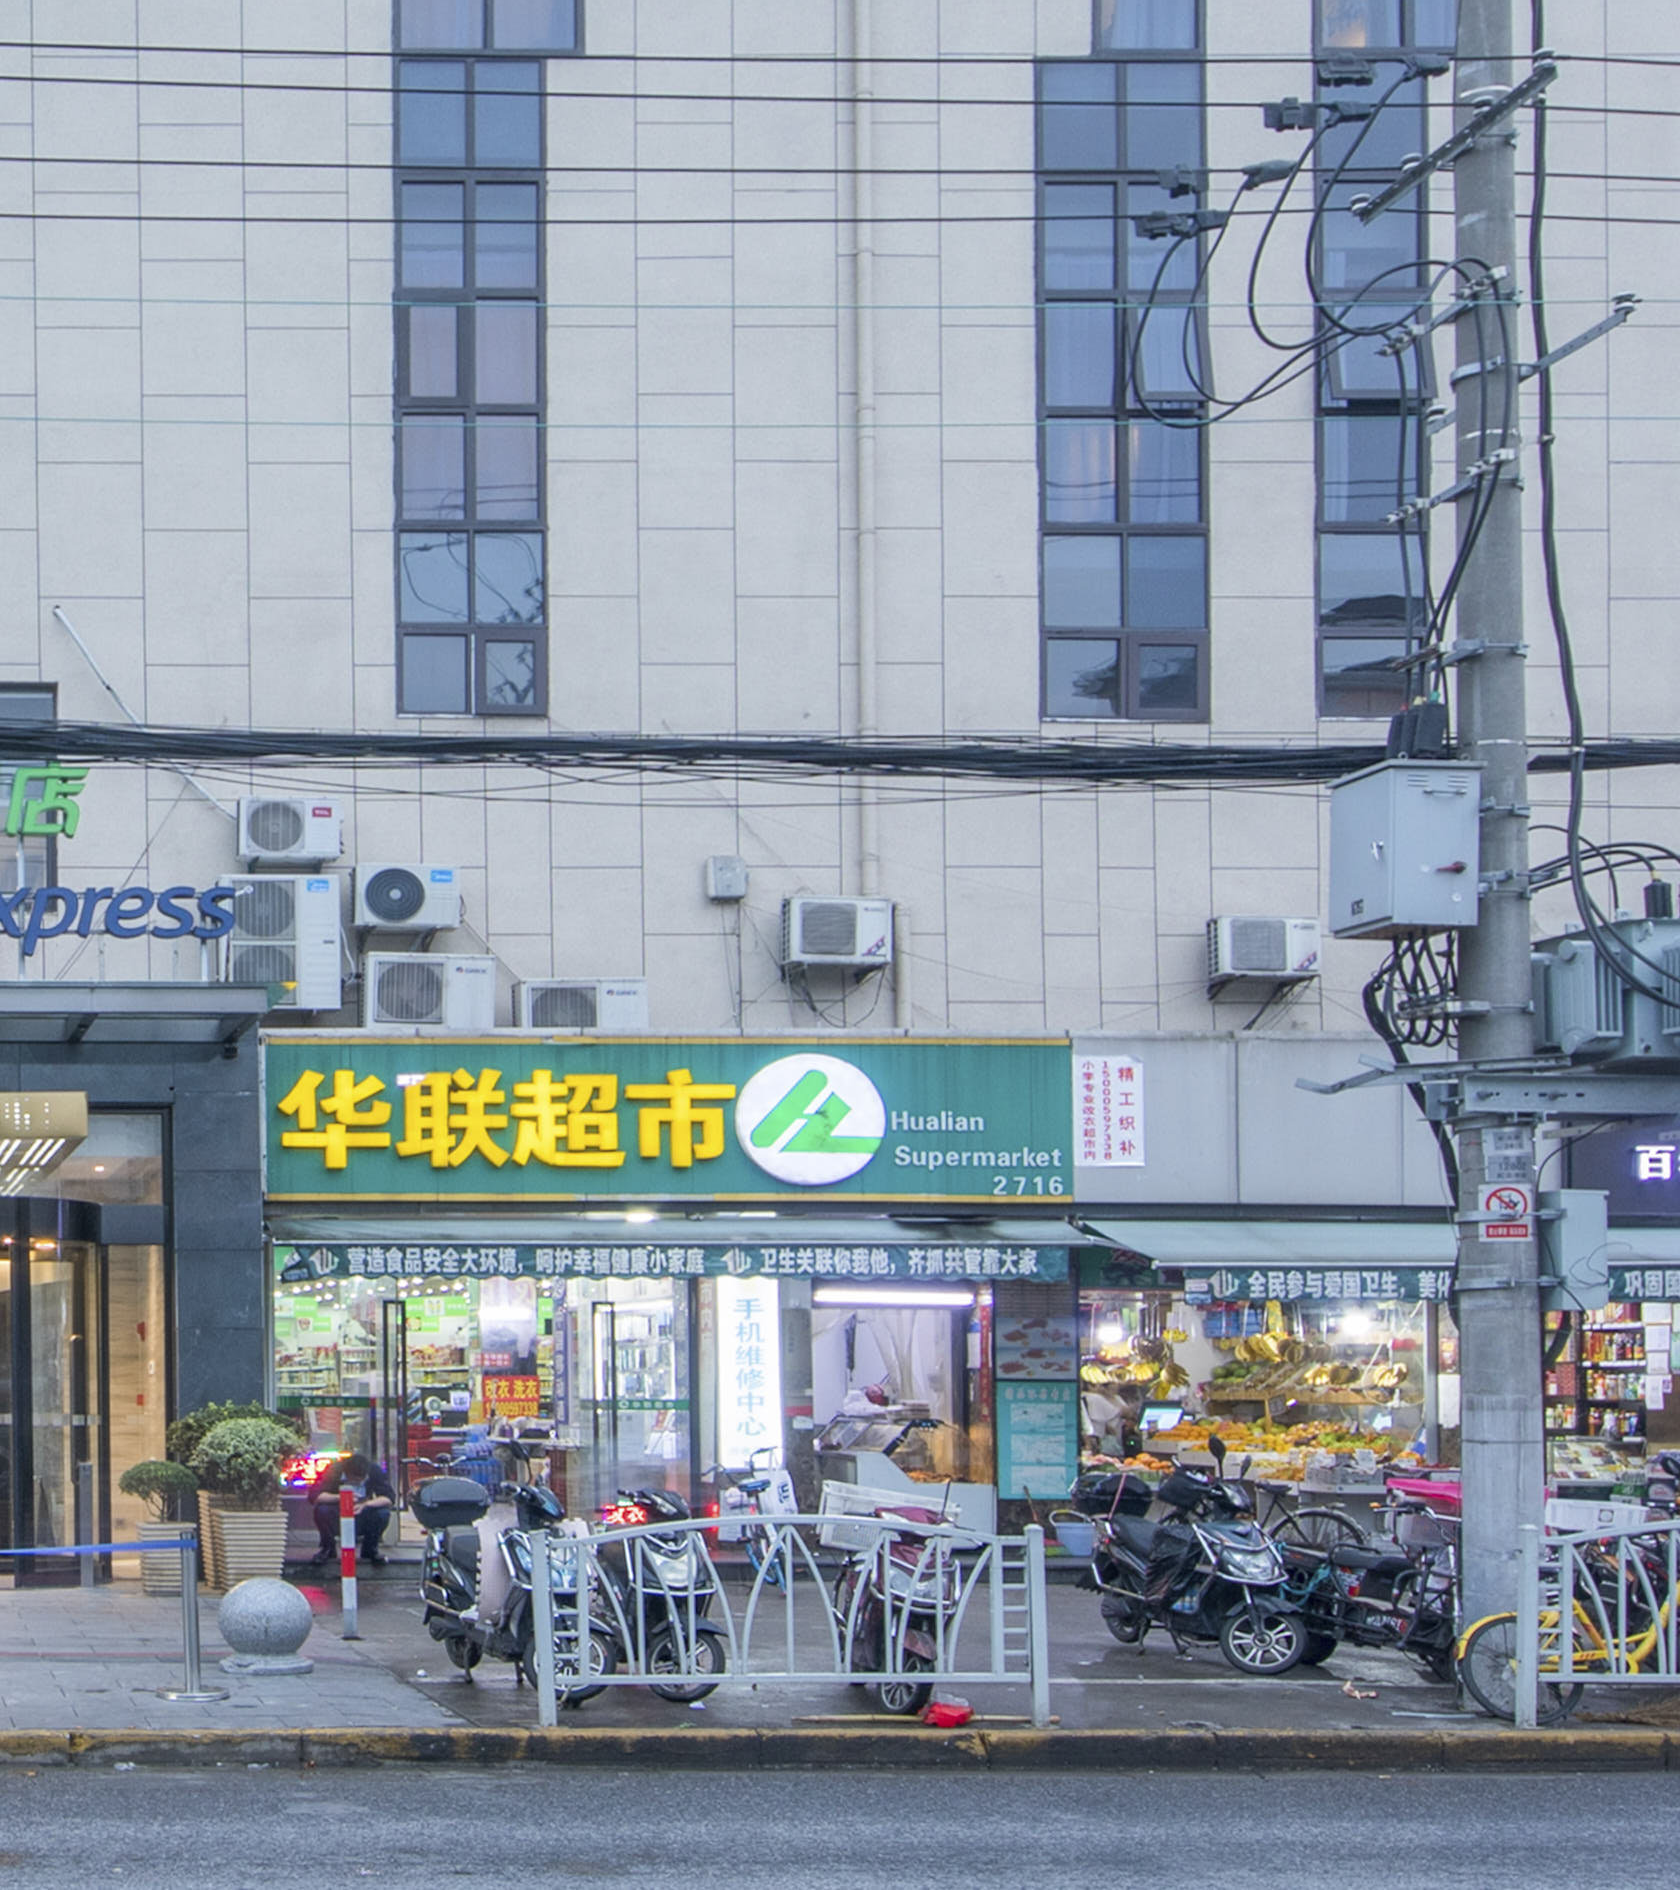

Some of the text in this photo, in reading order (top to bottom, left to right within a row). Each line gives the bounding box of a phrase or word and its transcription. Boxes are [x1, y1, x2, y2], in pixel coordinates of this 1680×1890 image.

[277, 1068, 736, 1170] 华联超市
[891, 1111, 985, 1132] Hualian
[1118, 1067, 1136, 1156] 精工织补
[894, 1145, 1063, 1171] Supermarket
[993, 1176, 1064, 1196] 2716
[734, 1297, 767, 1437] 手机维修中心
